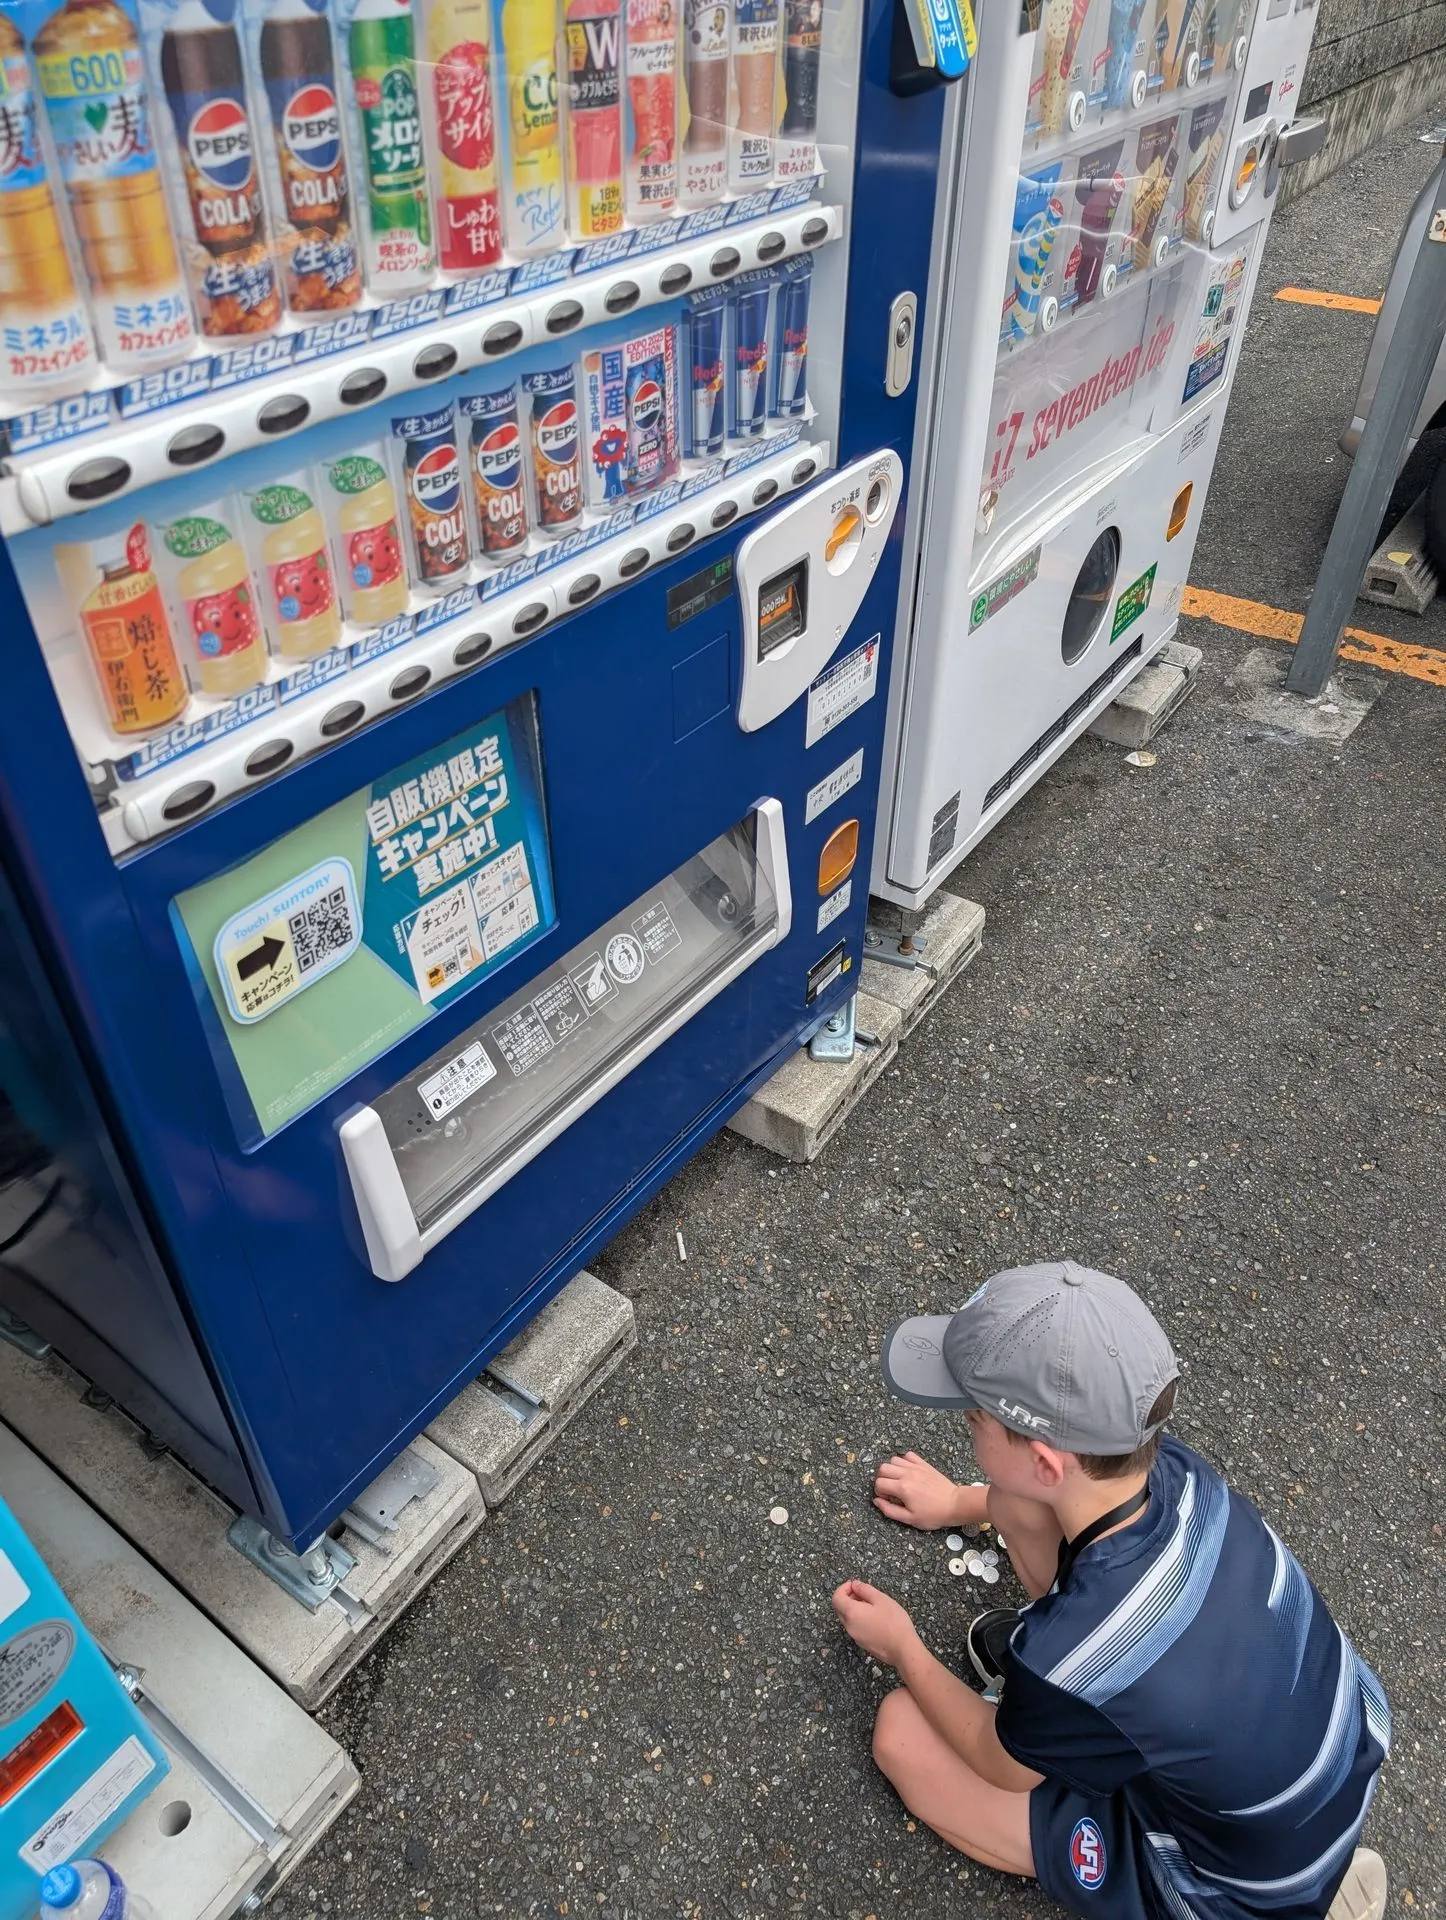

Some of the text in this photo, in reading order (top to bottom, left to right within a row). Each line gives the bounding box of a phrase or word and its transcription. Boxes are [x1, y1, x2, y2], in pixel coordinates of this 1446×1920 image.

[69, 52, 123, 92] 600
[199, 194, 251, 228] COLA
[291, 176, 339, 207] COLA
[601, 350, 625, 419] 国産
[1026, 342, 1144, 461] seventeen
[366, 735, 503, 840] 自販機限定
[377, 774, 509, 872] キャンペーン
[241, 962, 293, 1004] キャンペーン
[1080, 1823, 1098, 1881] AFL
